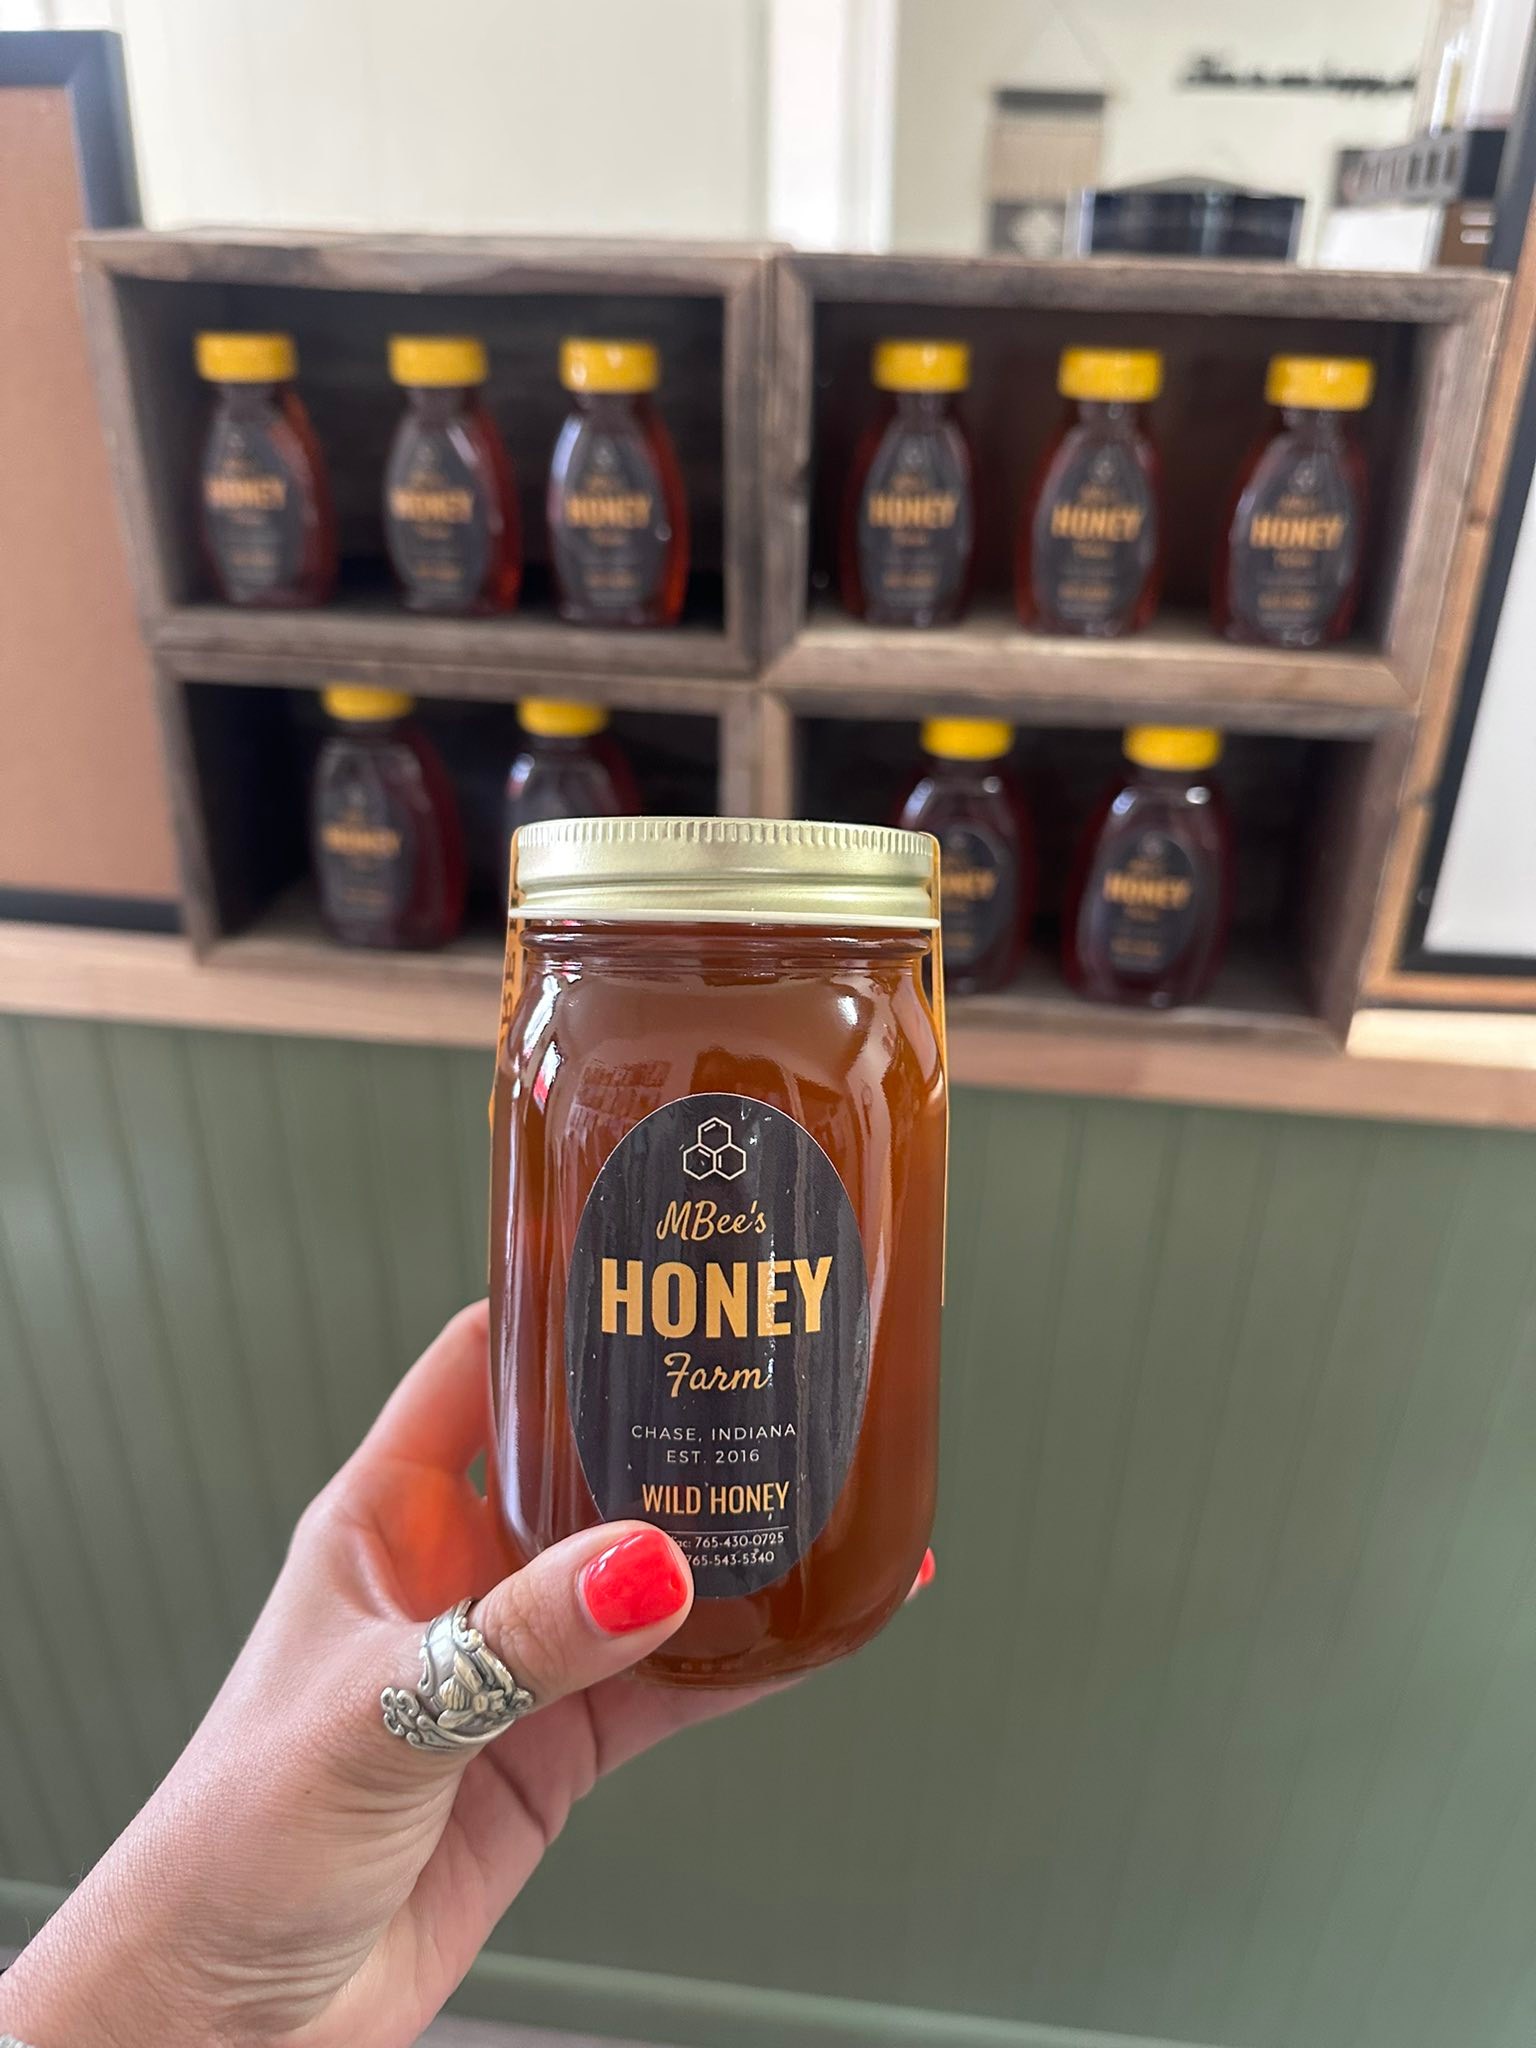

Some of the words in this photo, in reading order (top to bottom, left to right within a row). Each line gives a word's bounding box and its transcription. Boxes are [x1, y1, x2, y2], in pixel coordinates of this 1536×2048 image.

[1051, 505, 1143, 541] HONEY
[1250, 516, 1344, 550] HONEY
[656, 1200, 767, 1241] MBee's
[601, 1256, 833, 1338] HONEY
[663, 1352, 771, 1398] Farm
[631, 1425, 702, 1442] CHASE,
[711, 1423, 796, 1441] INDIANA
[666, 1450, 707, 1464] EST.
[715, 1449, 760, 1464] 2016
[642, 1483, 701, 1515] WILD
[710, 1481, 790, 1515] HONEY
[695, 1532, 785, 1549] 765-430-0725
